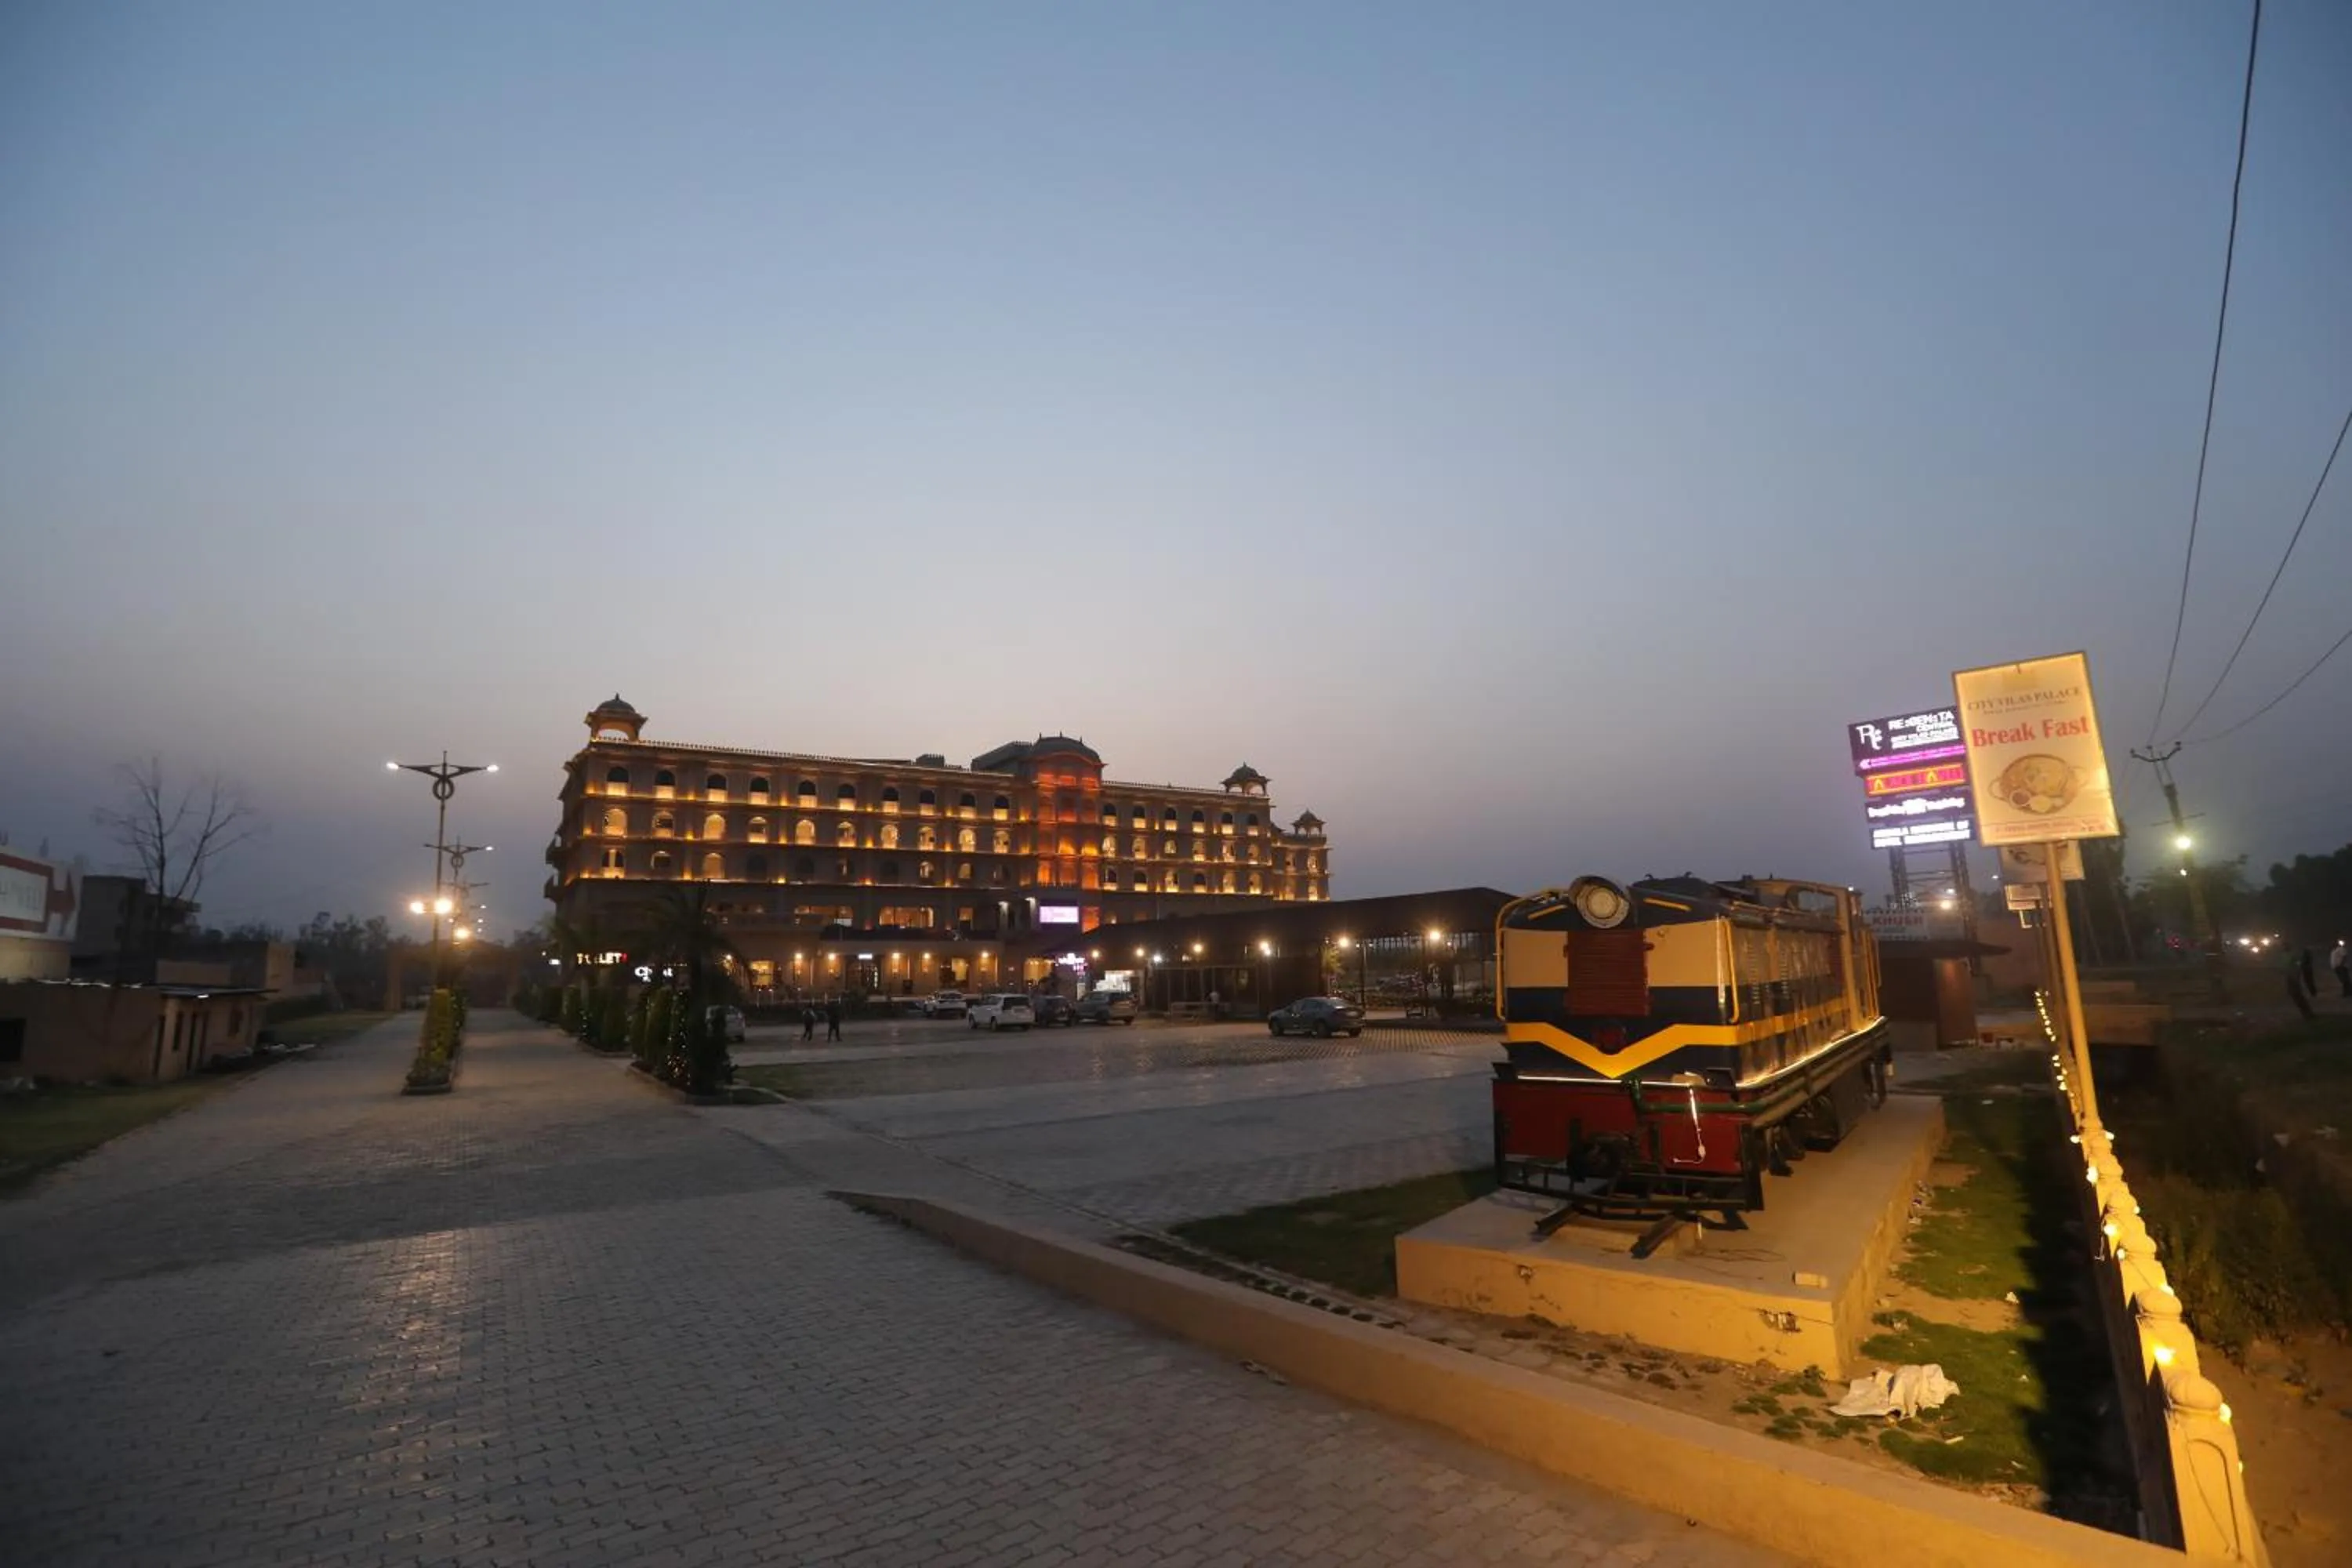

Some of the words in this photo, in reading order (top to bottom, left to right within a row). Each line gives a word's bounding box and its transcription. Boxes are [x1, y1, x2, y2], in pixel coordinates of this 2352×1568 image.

[2034, 687, 2079, 702] PALACE
[1973, 722, 2035, 747] Break
[2042, 716, 2089, 739] Fast
